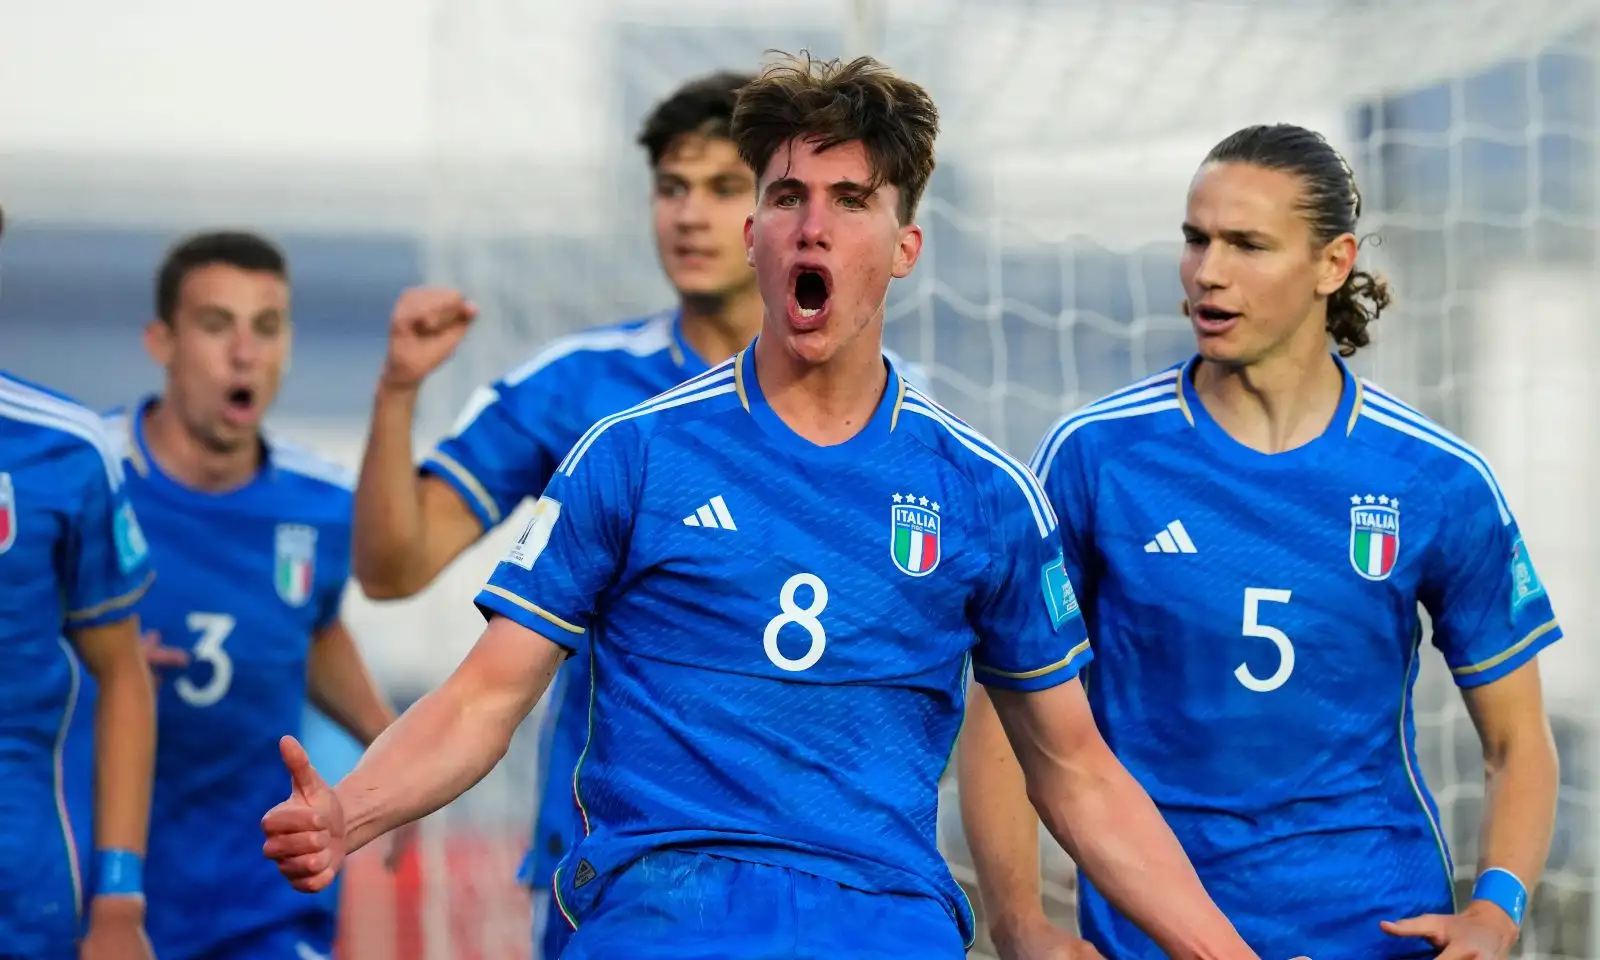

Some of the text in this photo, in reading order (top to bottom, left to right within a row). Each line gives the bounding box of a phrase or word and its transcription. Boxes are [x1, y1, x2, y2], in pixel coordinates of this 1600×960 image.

[896, 508, 937, 530] ITALIA
[1356, 511, 1395, 529] ITALIA
[174, 612, 235, 707] 3
[763, 573, 828, 672] 8
[1234, 587, 1294, 692] 5
